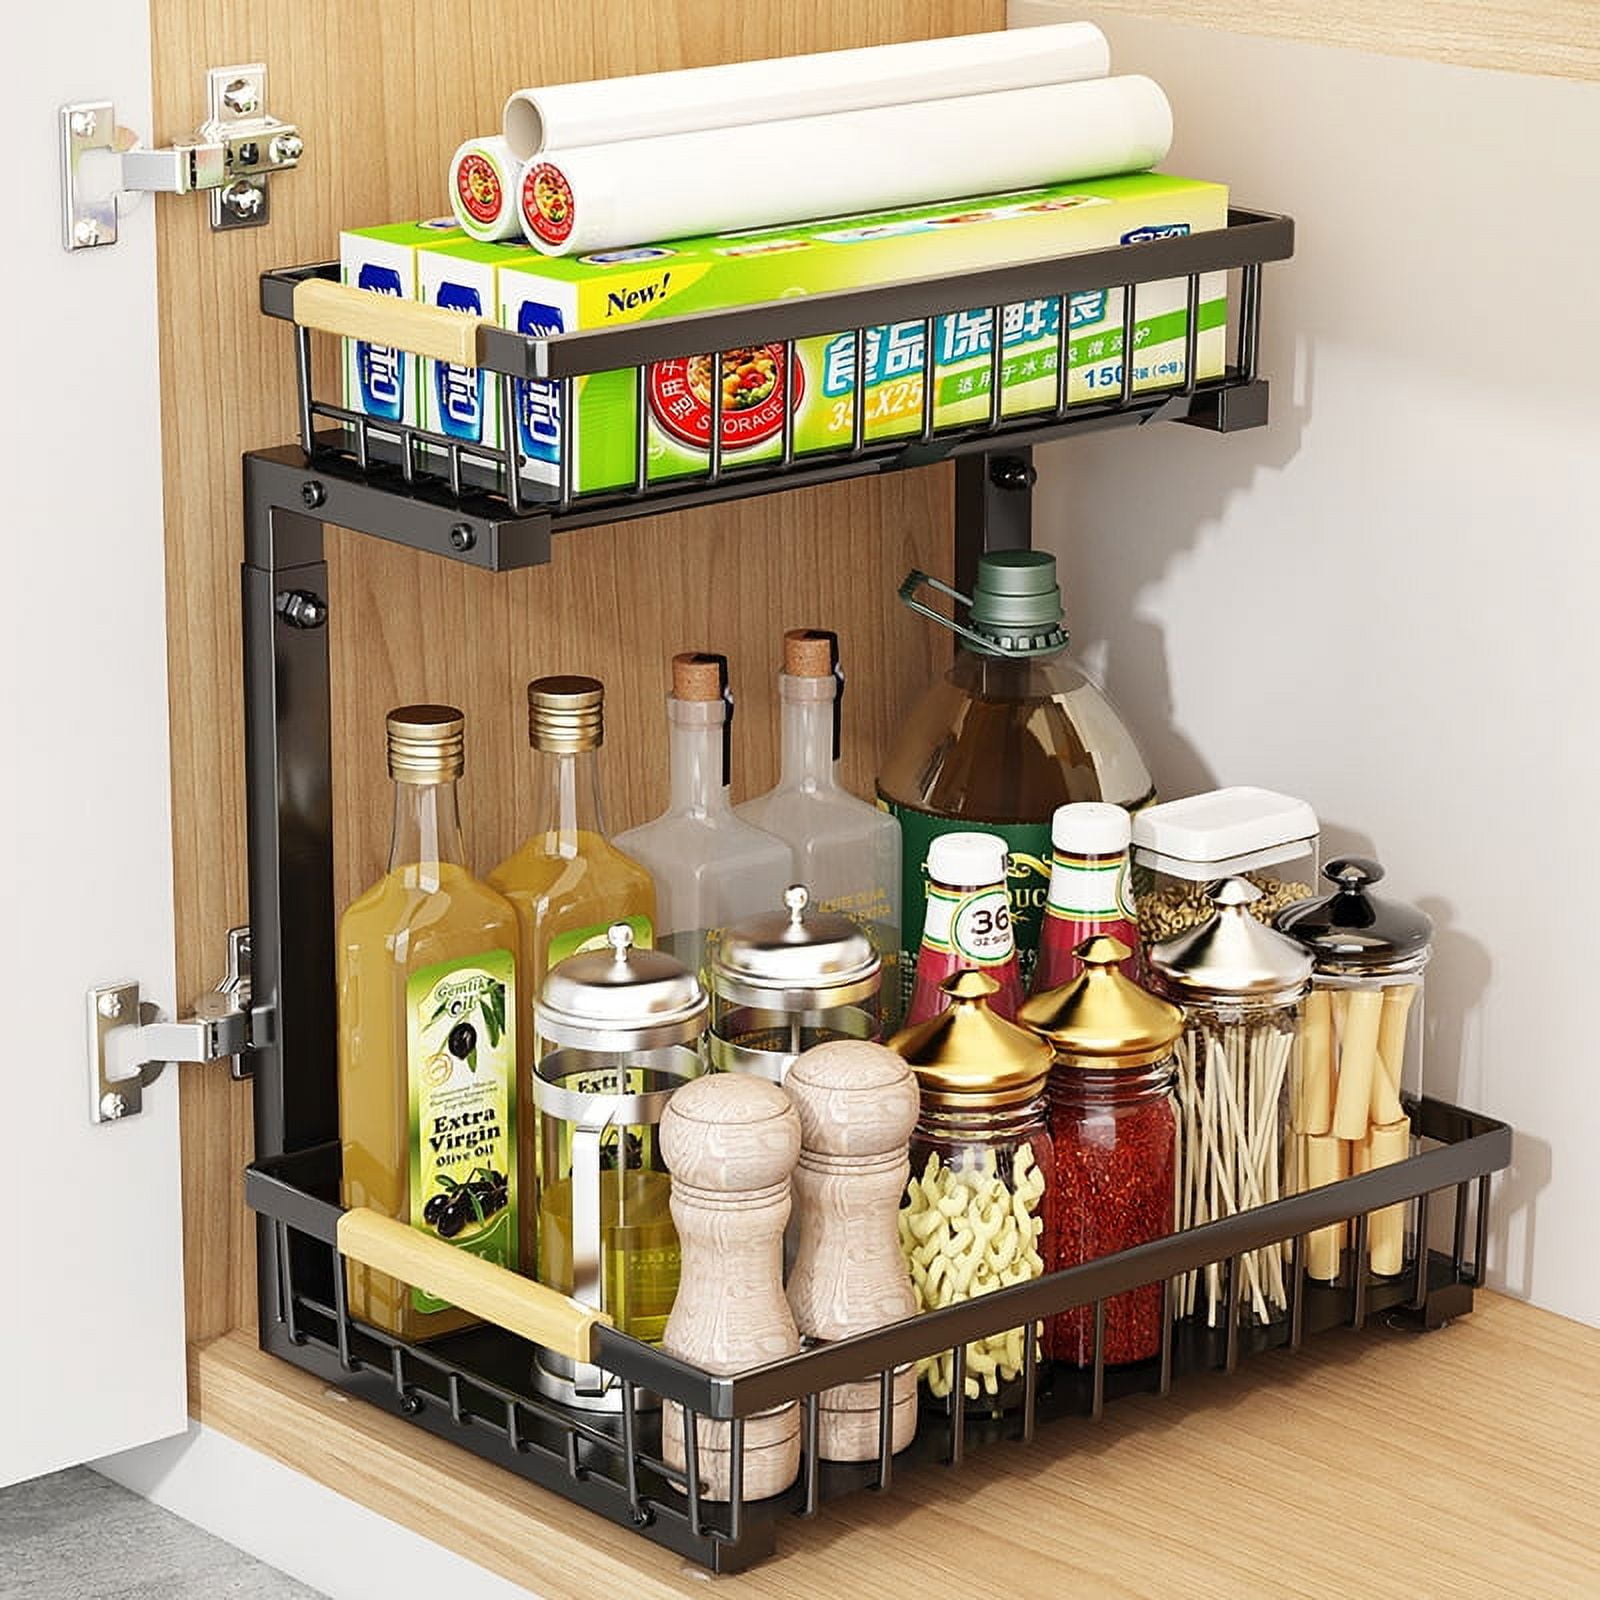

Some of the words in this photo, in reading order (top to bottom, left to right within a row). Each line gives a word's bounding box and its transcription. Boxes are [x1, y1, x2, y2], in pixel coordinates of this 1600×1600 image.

[605, 272, 671, 318] New!
[696, 402, 784, 433] SORAGE
[971, 904, 1009, 935] 36
[450, 994, 474, 1015] Oil
[433, 1108, 496, 1135] Extra
[429, 1125, 501, 1153] Virgin
[436, 1152, 471, 1168] Olive
[474, 1144, 494, 1158] Oil
